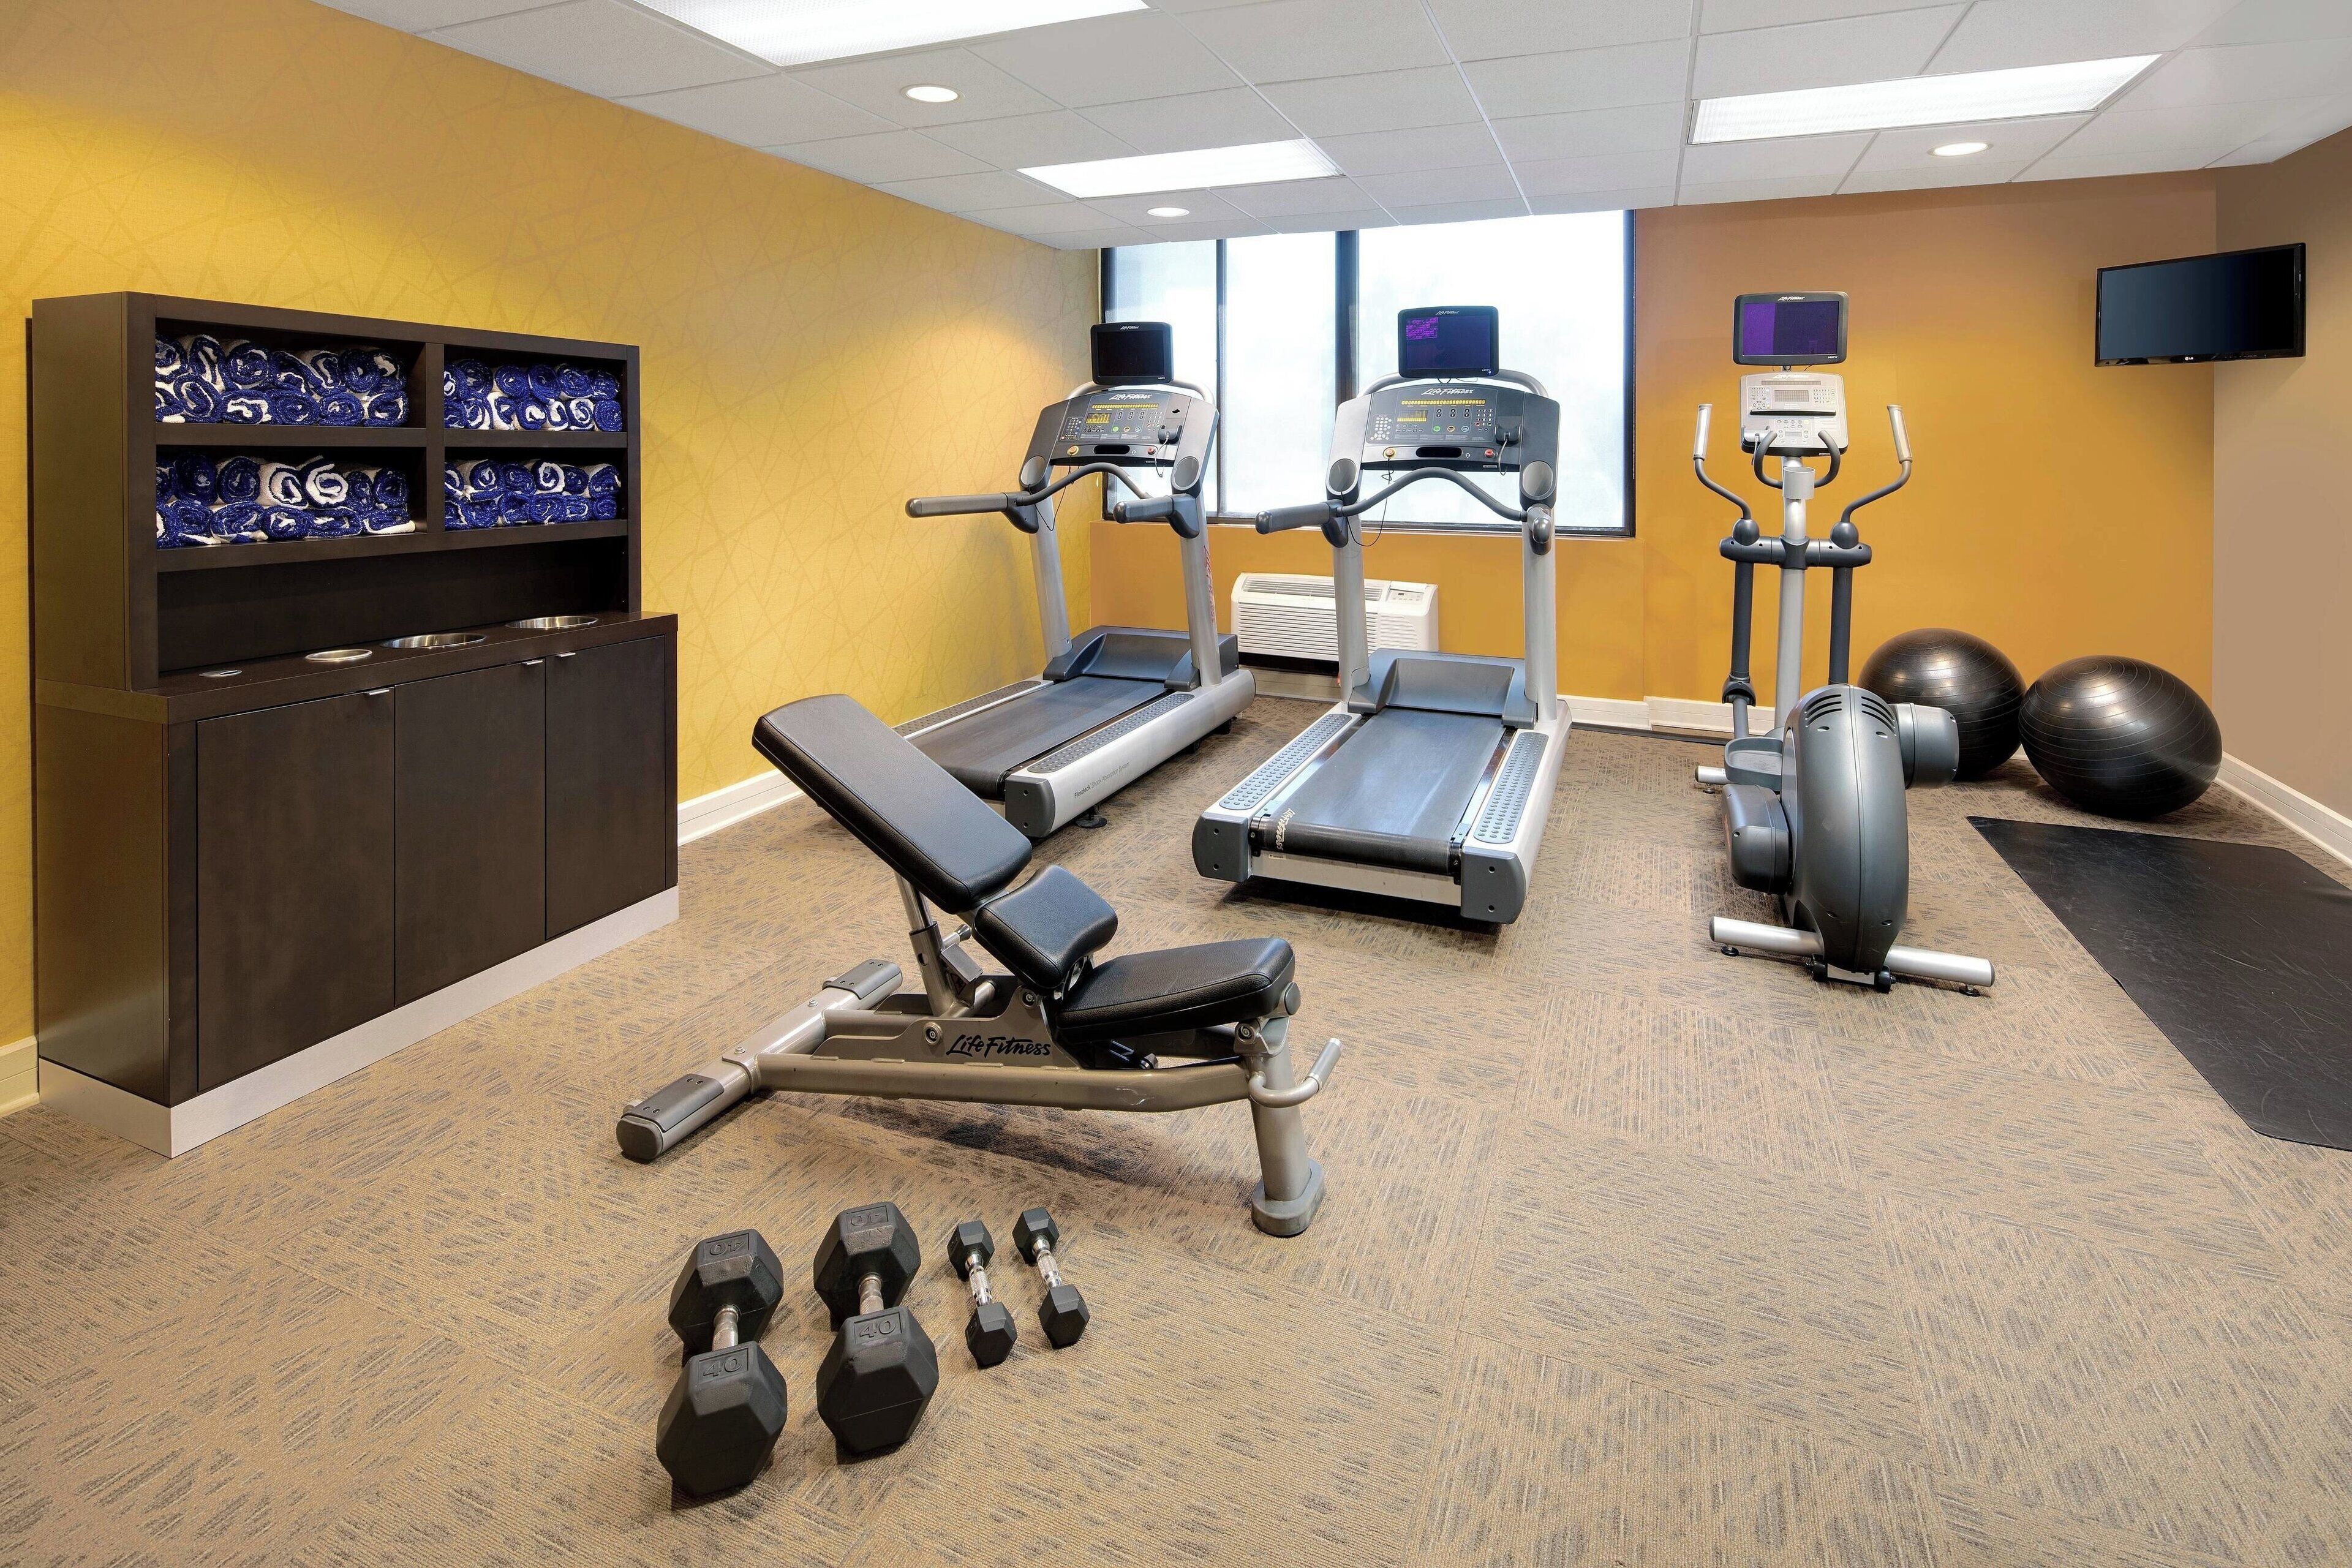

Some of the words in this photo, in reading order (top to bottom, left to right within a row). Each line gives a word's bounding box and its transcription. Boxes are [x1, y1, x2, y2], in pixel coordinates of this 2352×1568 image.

[709, 1240, 745, 1256] 40
[859, 1319, 896, 1338] 40
[703, 1355, 742, 1378] 40
